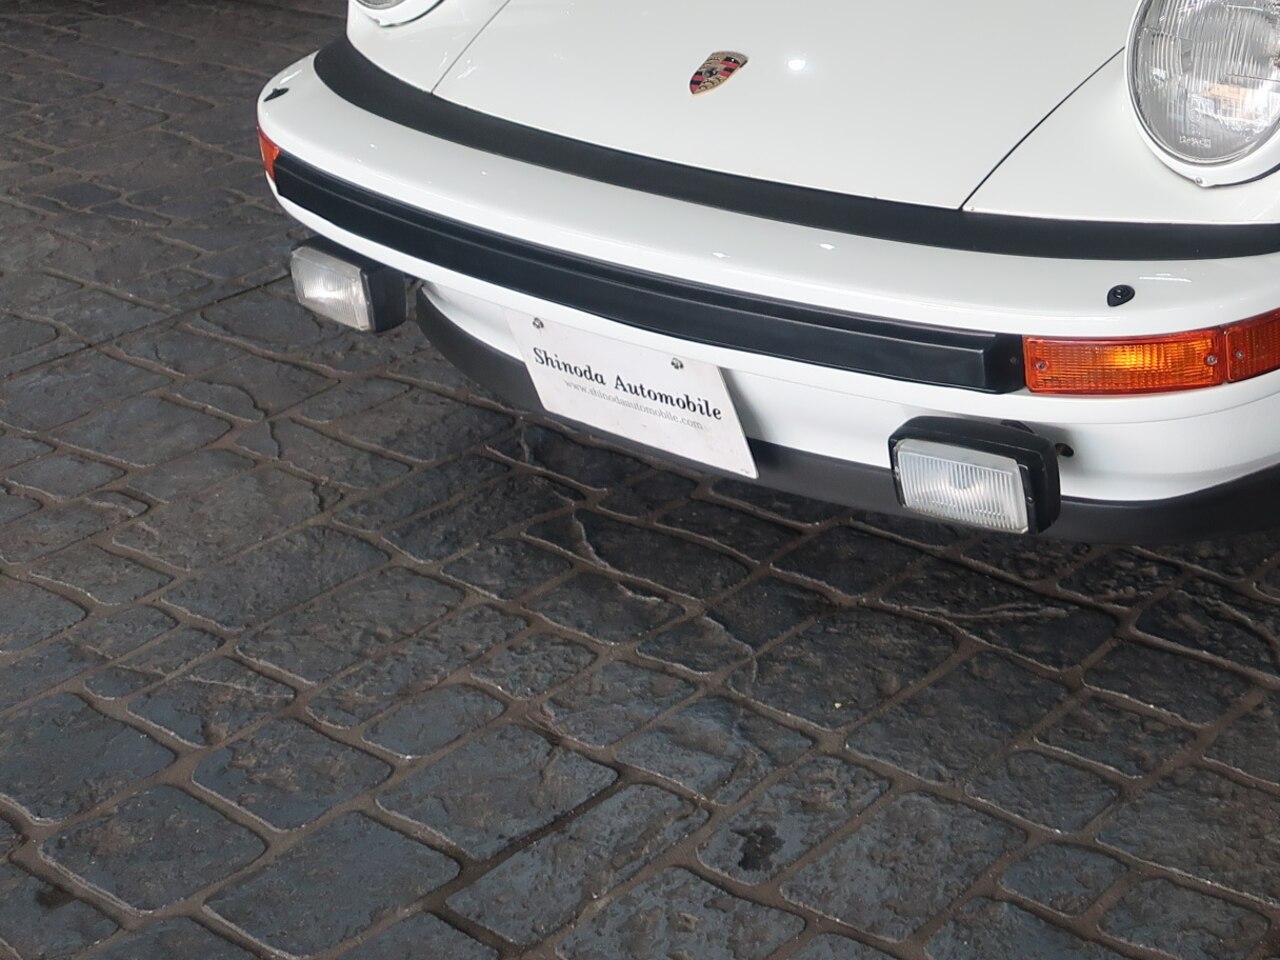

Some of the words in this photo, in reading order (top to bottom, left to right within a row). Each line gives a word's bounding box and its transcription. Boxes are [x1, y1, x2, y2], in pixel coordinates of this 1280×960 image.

[532, 346, 606, 386] Shinoda
[614, 375, 723, 421] Automobile
[564, 380, 704, 431] www.shinodaautomobile.com
